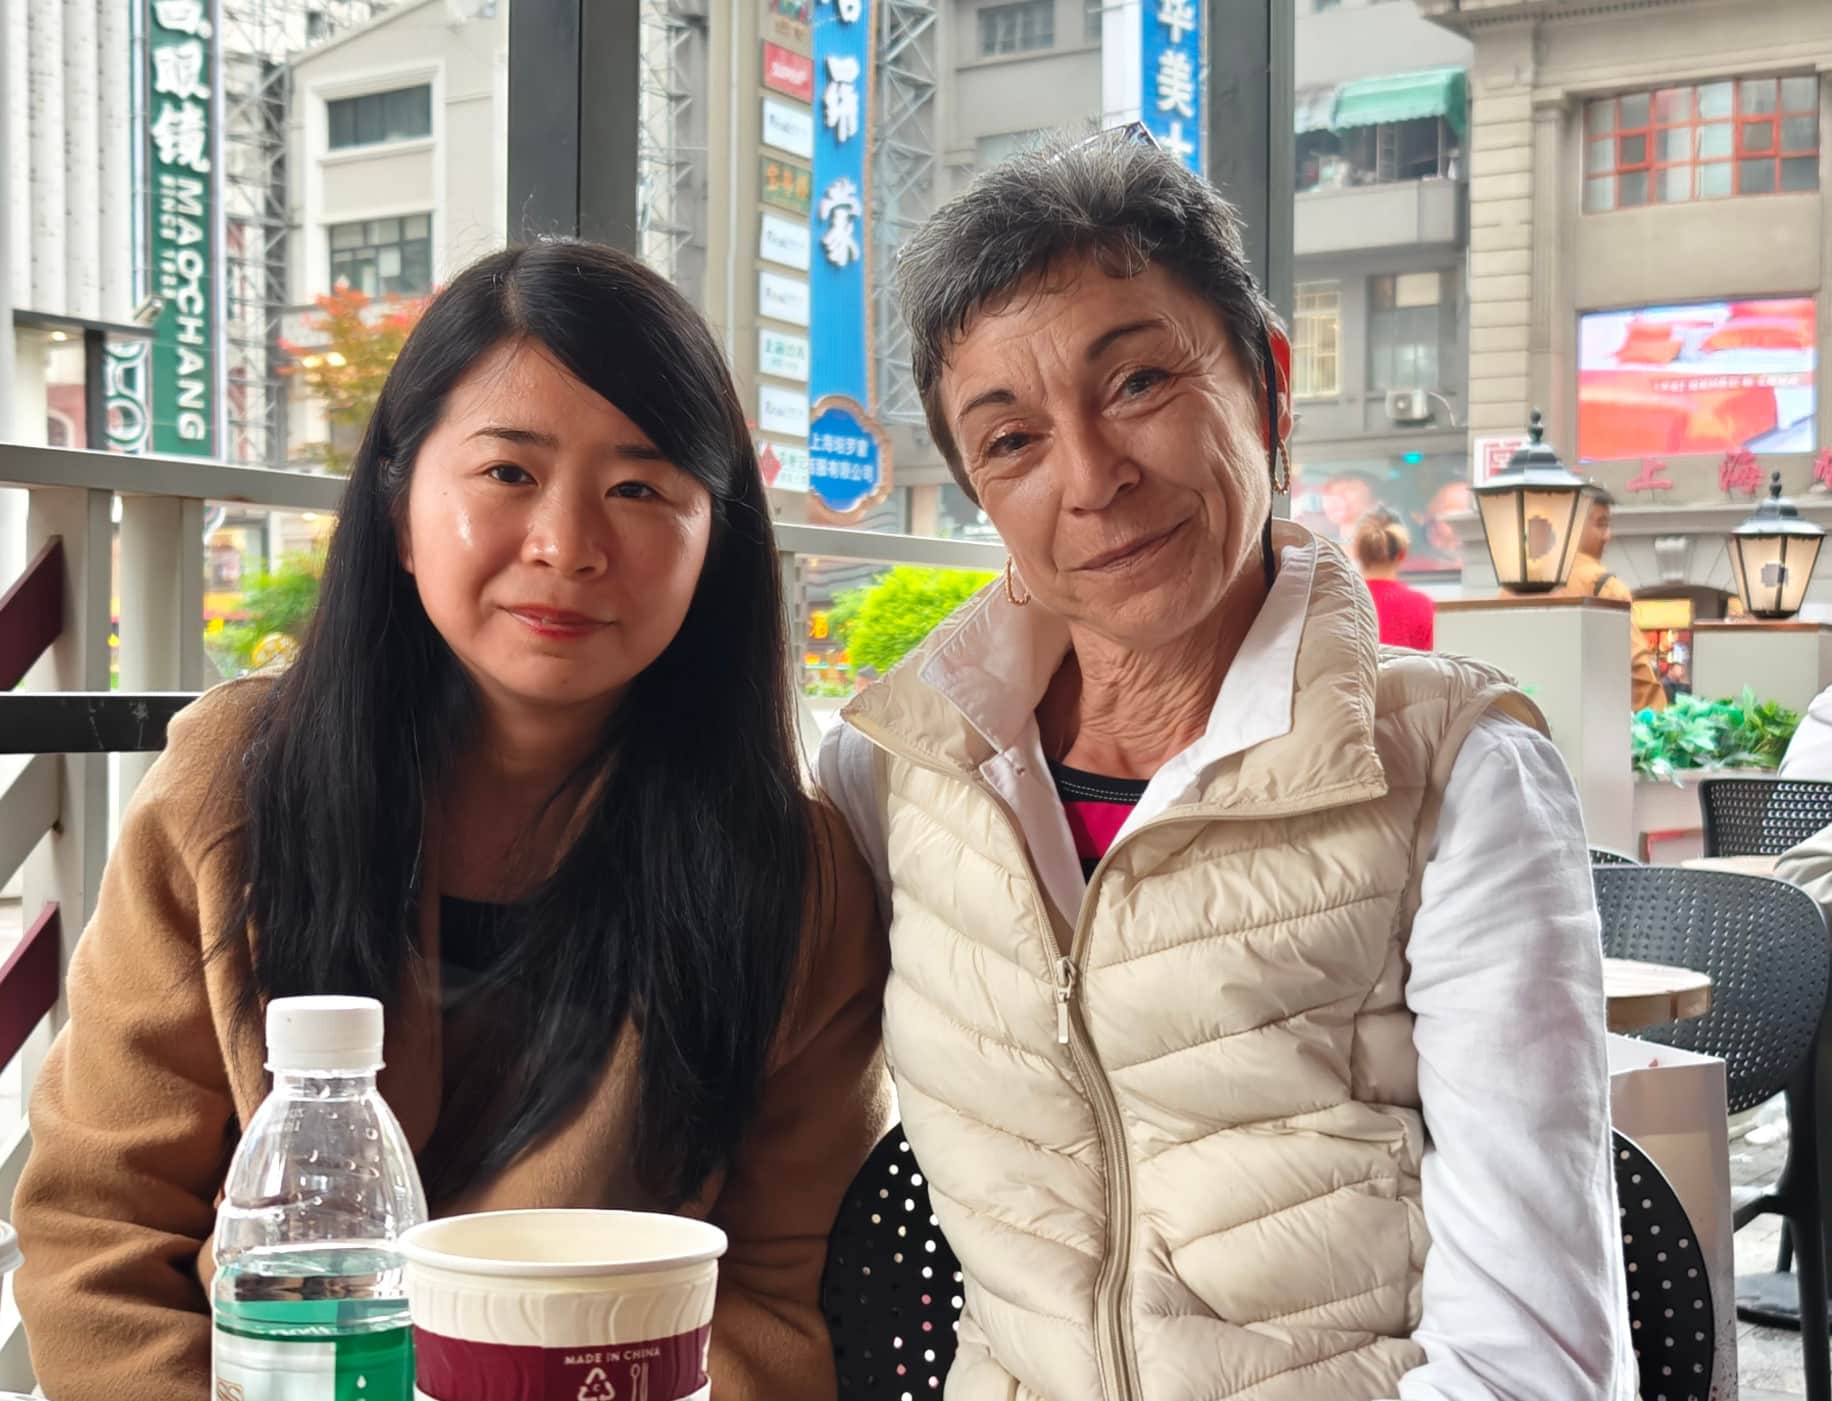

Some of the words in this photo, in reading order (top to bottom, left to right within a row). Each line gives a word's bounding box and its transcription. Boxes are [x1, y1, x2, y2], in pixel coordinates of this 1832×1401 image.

[564, 1353, 603, 1365] MADE
[606, 1351, 621, 1363] IN
[623, 1347, 661, 1361] CHINA
